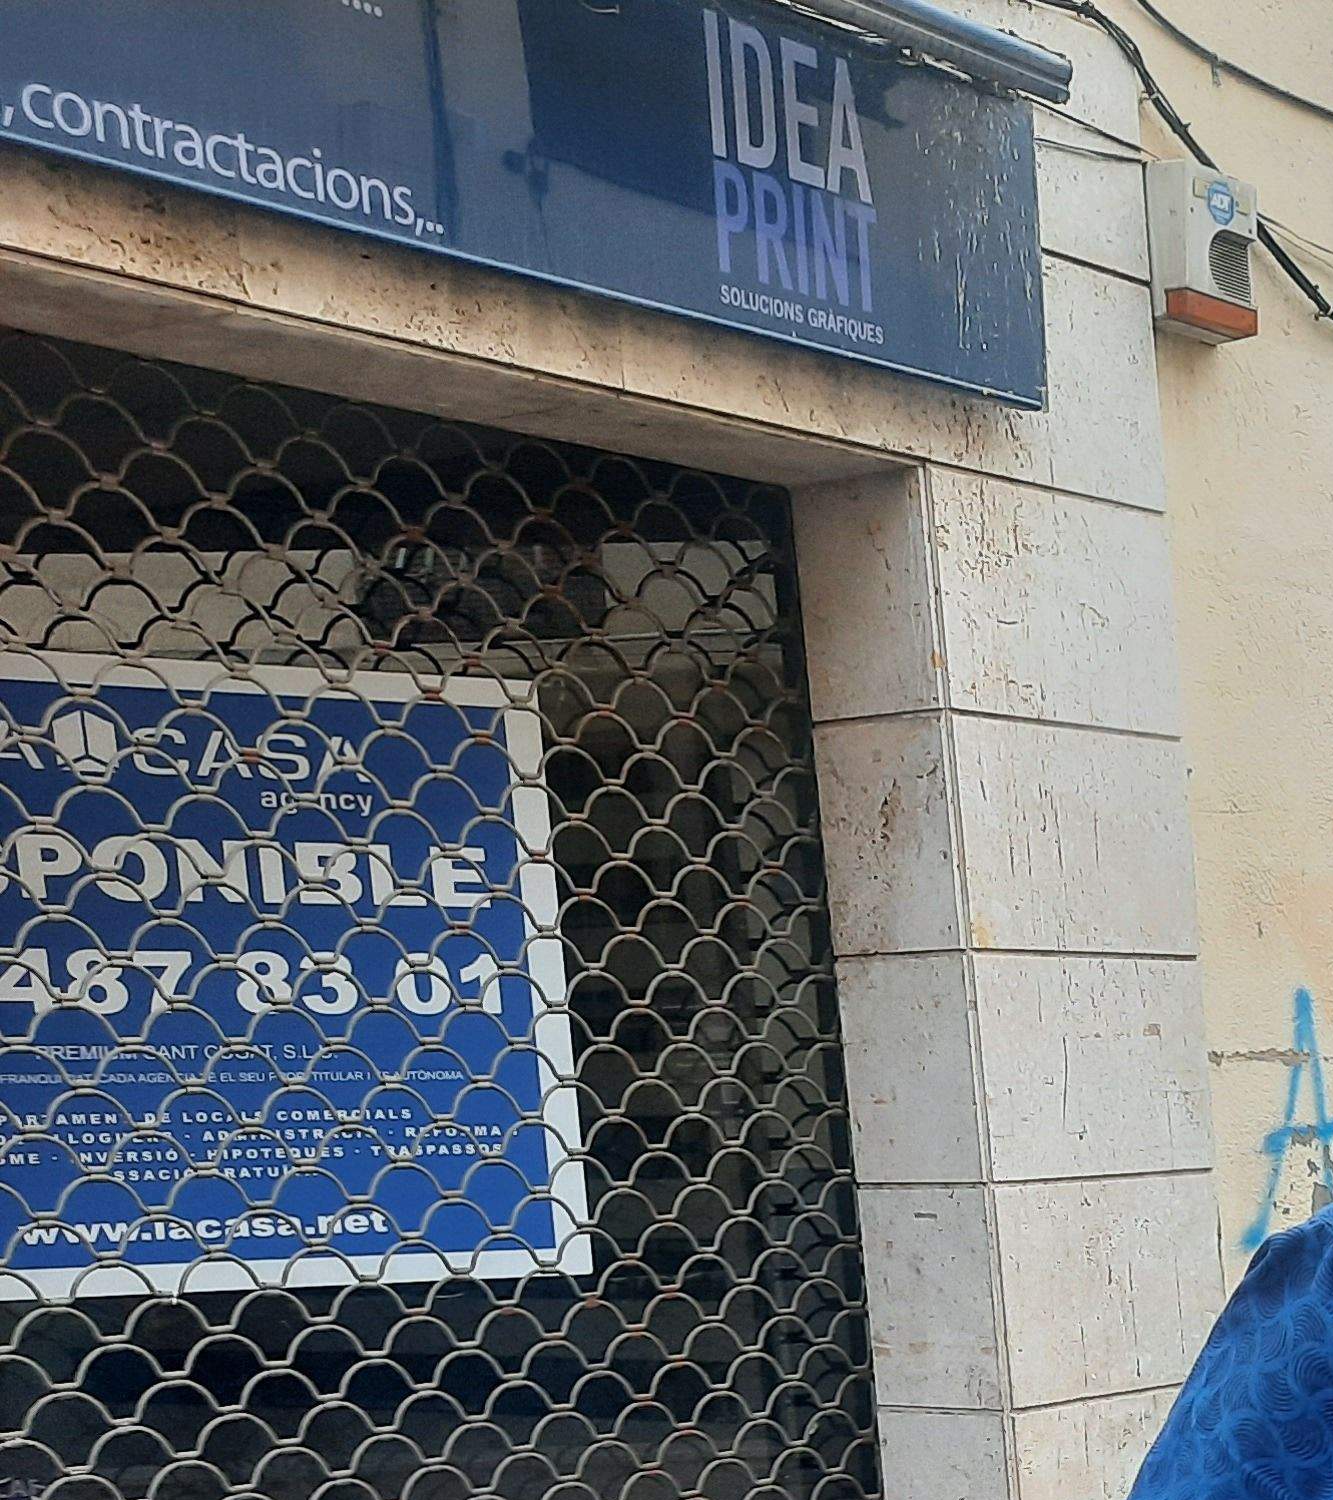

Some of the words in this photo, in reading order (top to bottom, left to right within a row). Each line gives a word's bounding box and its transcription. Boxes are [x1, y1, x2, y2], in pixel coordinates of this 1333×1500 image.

[703, 8, 874, 205] IDEA
[713, 159, 878, 313] PRINT
[720, 284, 805, 325] SOLUCIONS
[807, 306, 885, 346] GRÀFIQUES
[131, 726, 373, 784] CASA
[260, 789, 373, 817] agncy
[0, 833, 492, 908] PONIBLE
[236, 951, 358, 1015] 83
[396, 952, 503, 1015] 01
[142, 1044, 199, 1060] SANT
[101, 1073, 136, 1084] CADA
[220, 1072, 236, 1083] EL
[239, 1072, 266, 1083] SEU
[313, 1070, 365, 1082] TITULAR
[144, 1112, 171, 1124] DE
[275, 1108, 412, 1122] COMERCIALS
[70, 1147, 179, 1164] NVERSIÓ
[206, 1145, 345, 1161] HIPOTEQUES
[17, 1209, 391, 1247] www.lacasa.net
